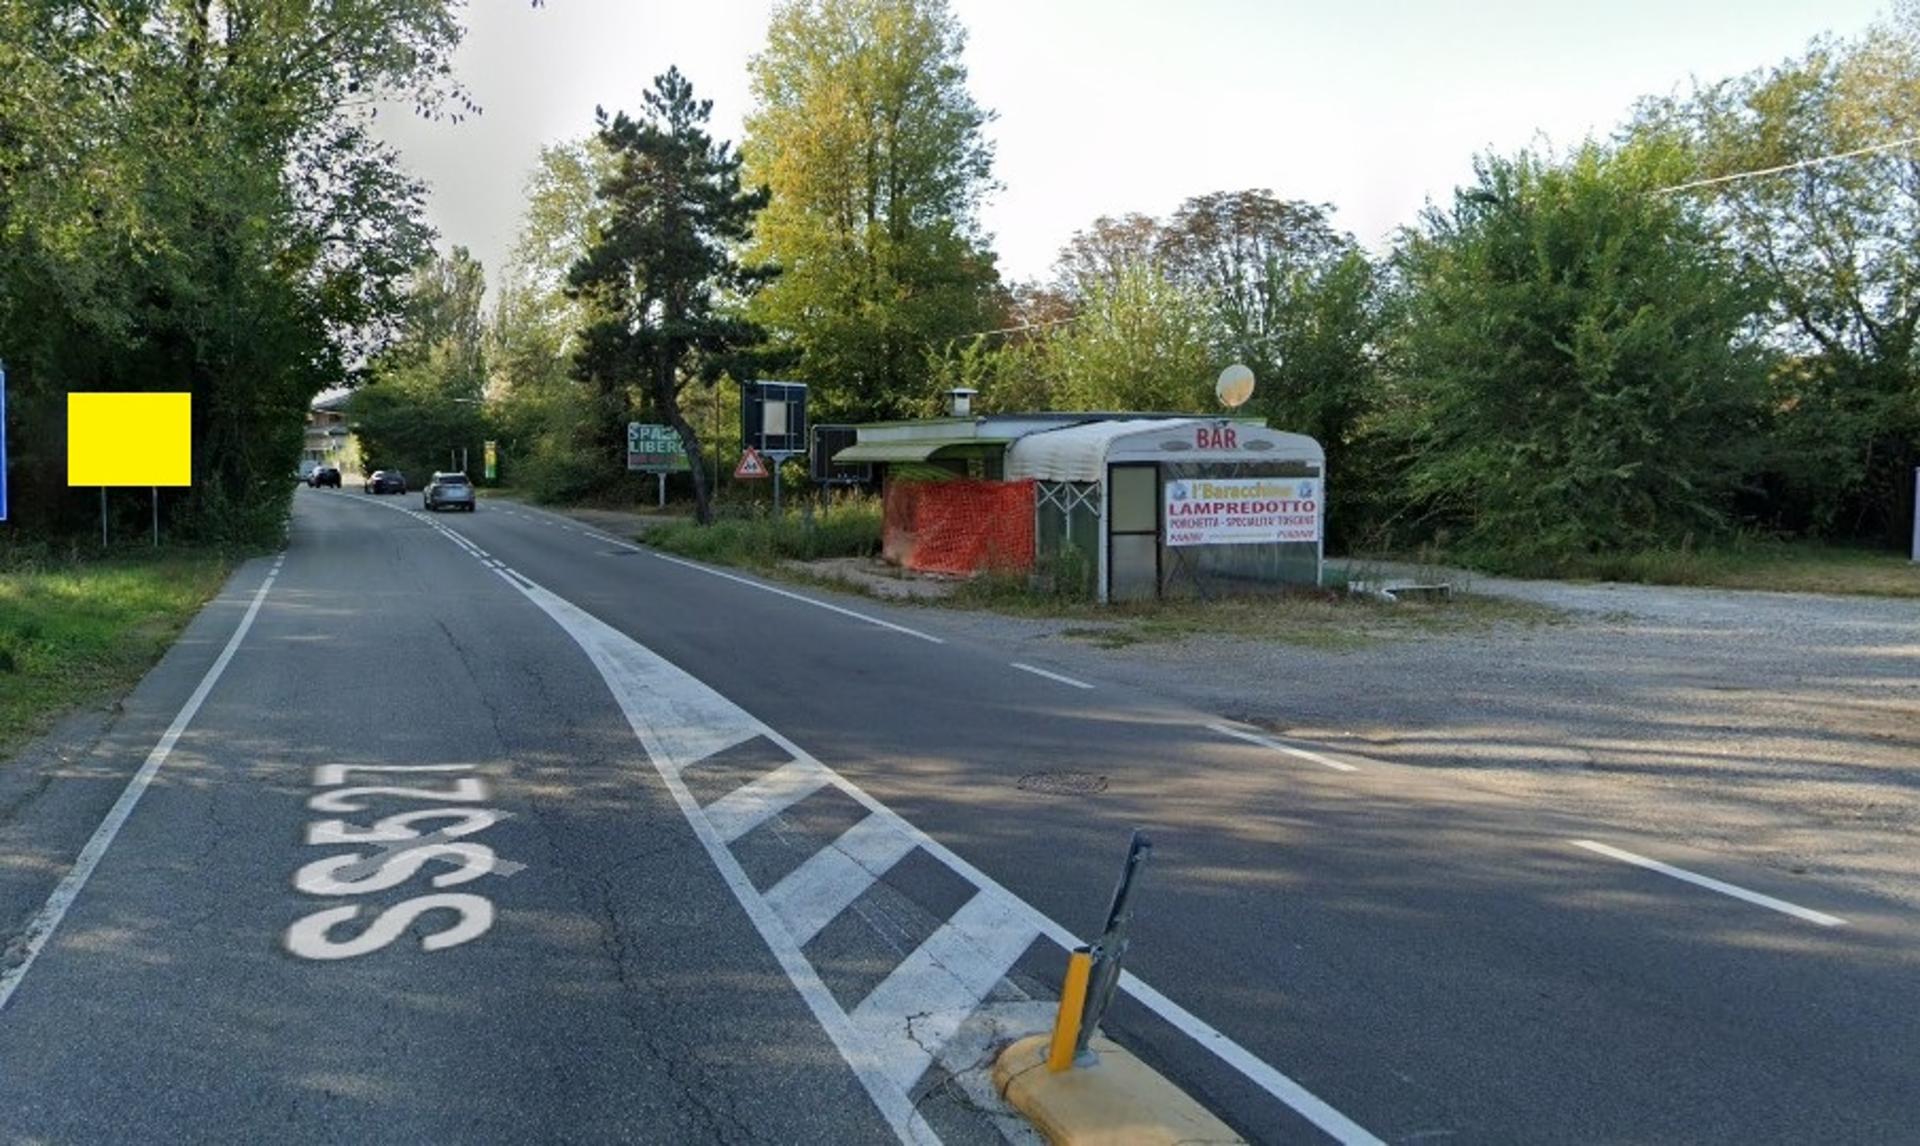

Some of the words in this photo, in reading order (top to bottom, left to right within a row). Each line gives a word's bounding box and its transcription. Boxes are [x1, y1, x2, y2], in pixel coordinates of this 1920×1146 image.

[630, 426, 682, 440] SPAZI
[1196, 427, 1237, 449] BAR
[1191, 482, 1292, 500] l'Baracchi
[1169, 500, 1316, 516] LAMPREDOTTO
